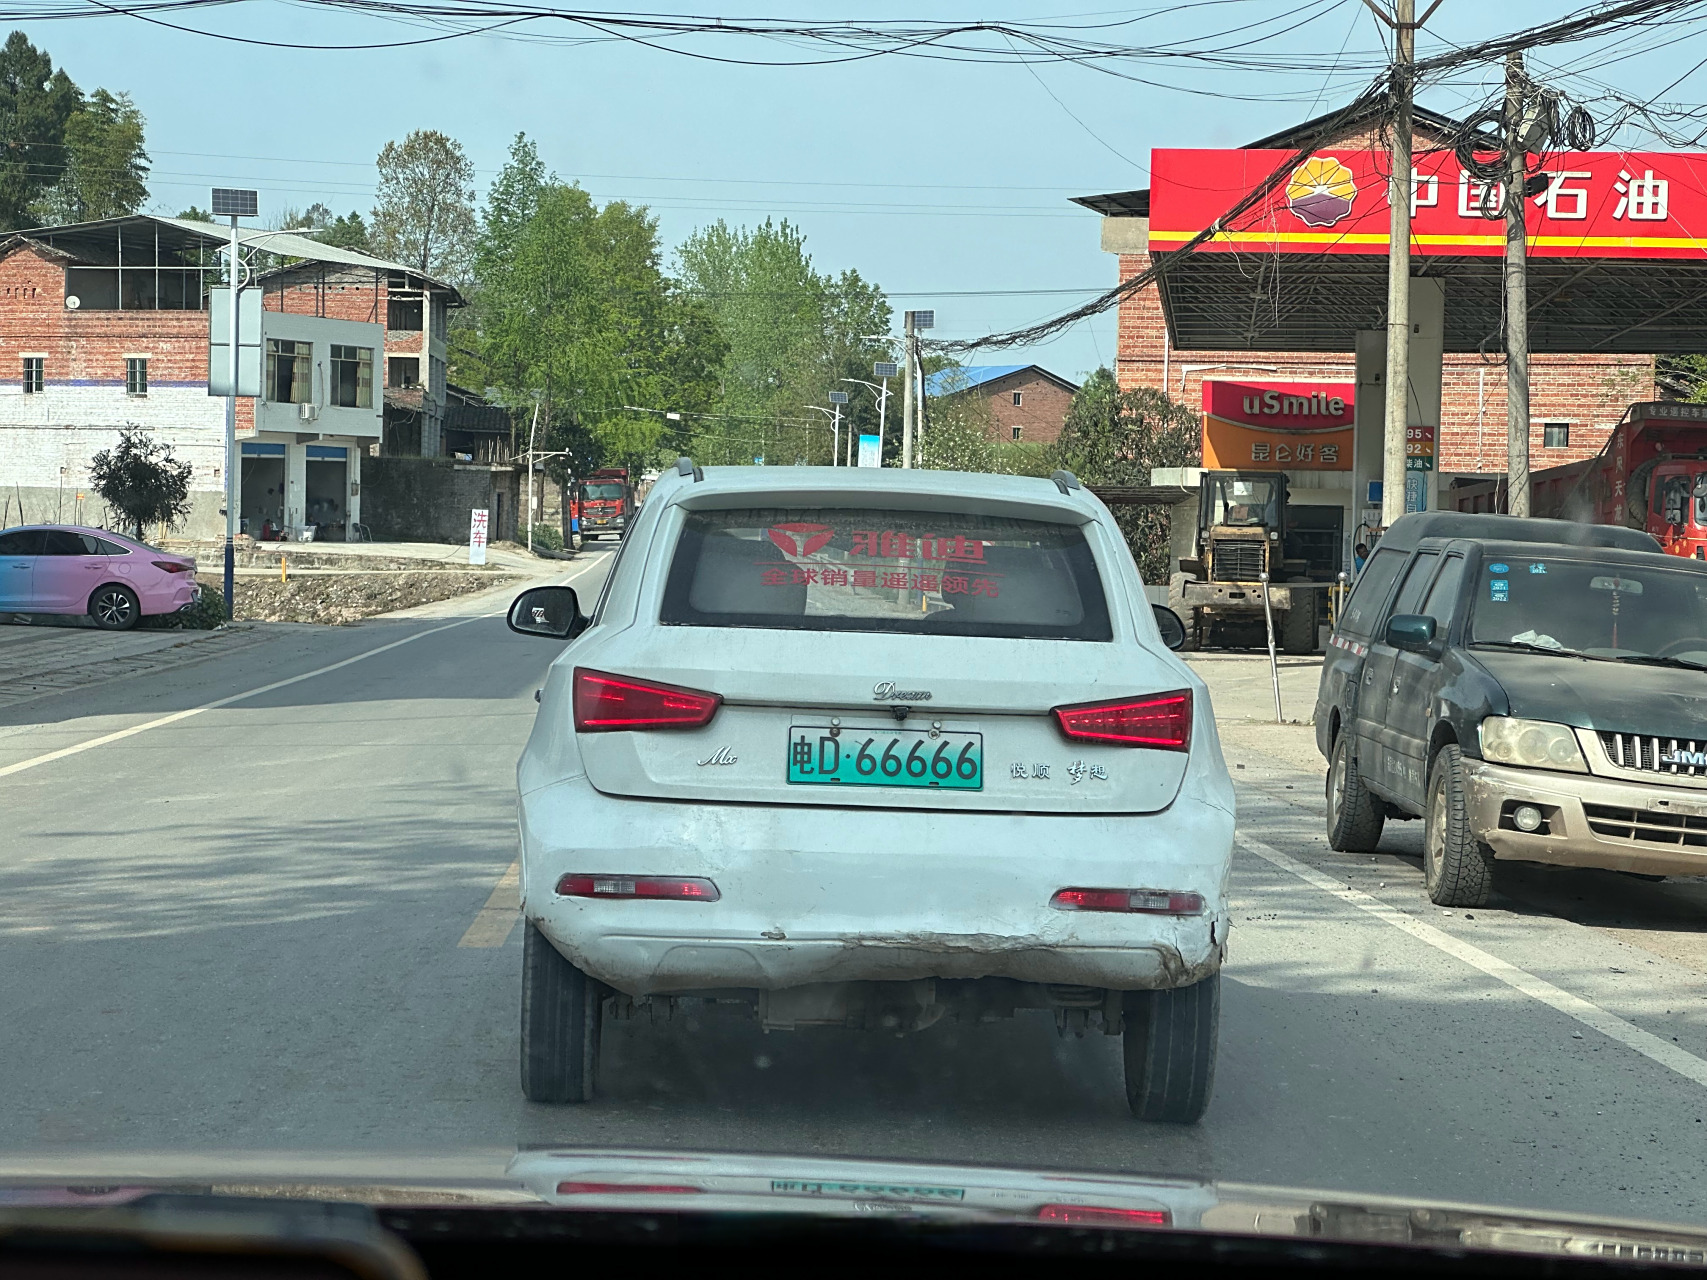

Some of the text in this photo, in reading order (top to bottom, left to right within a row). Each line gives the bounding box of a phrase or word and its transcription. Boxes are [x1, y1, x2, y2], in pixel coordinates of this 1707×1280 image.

[1242, 390, 1345, 416] uSmile
[1406, 429, 1422, 439] 95
[1251, 442, 1339, 463] 昆仑好客
[1406, 443, 1422, 454] 92
[473, 511, 488, 548] 洗车
[849, 530, 988, 563] 雅迪
[760, 567, 999, 598] 全球销量遥遥领先
[873, 681, 932, 701] Dream
[1660, 749, 1707, 767] JM
[1010, 760, 1109, 786] 悦顺 梦想
